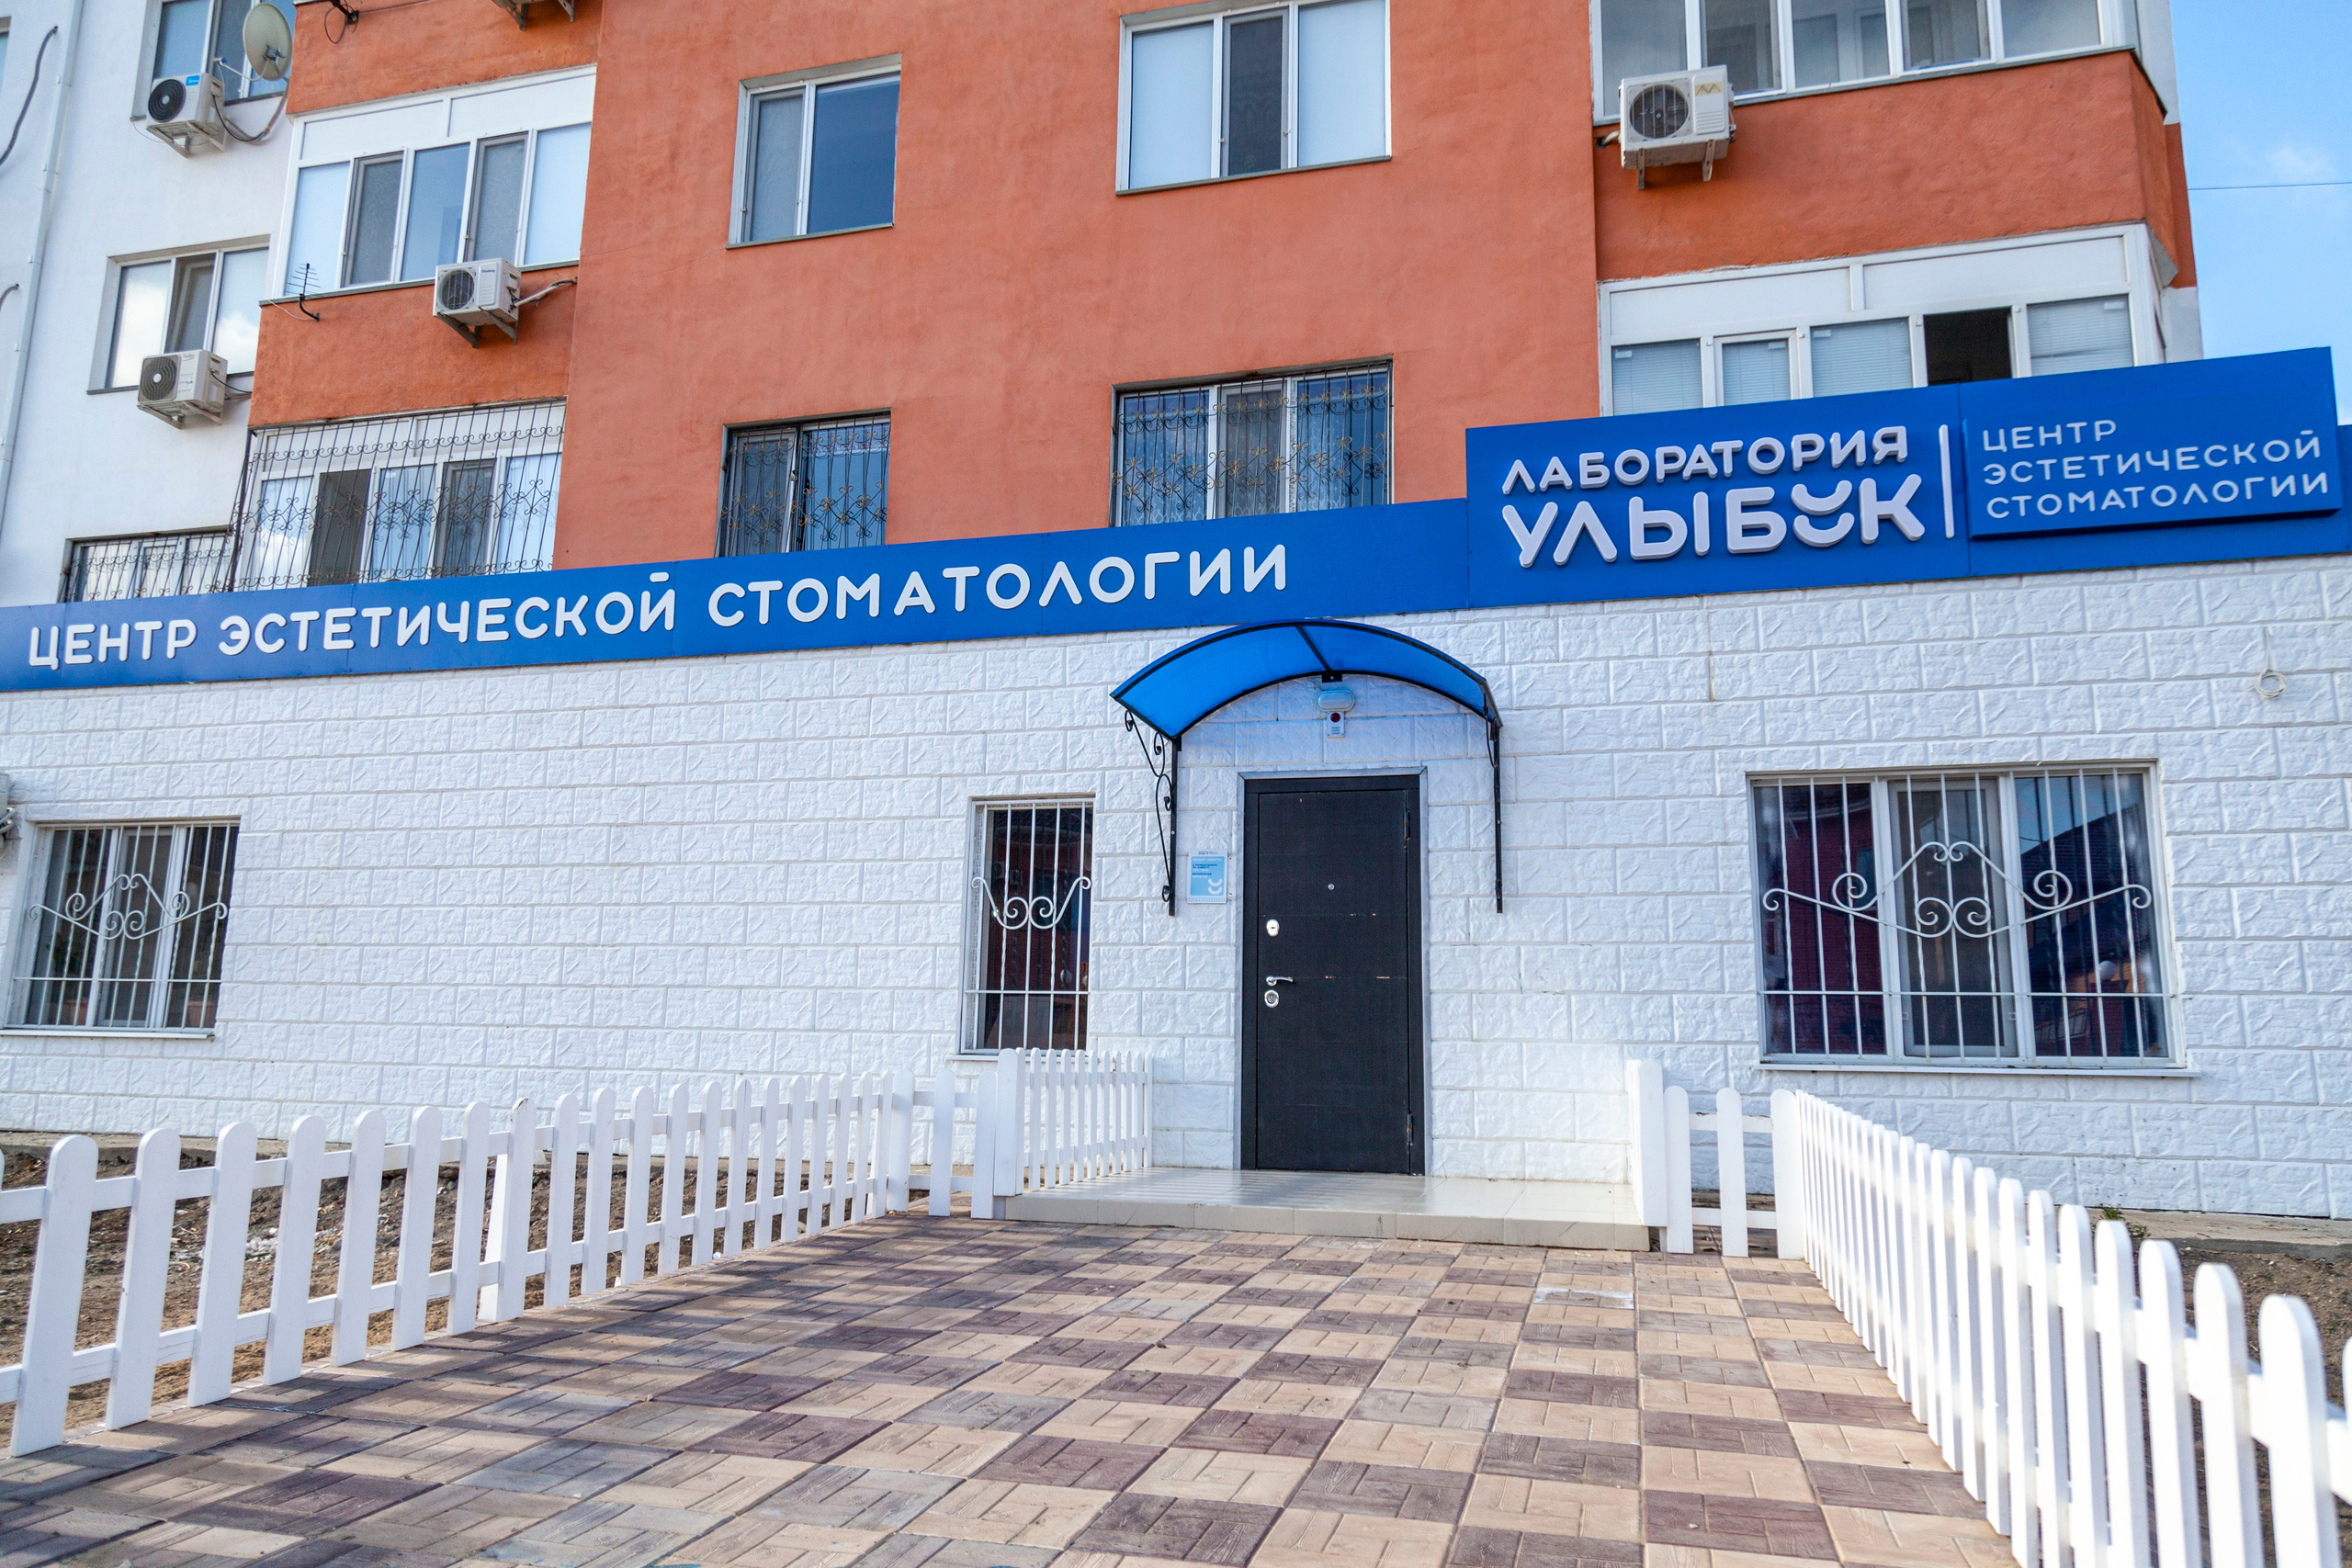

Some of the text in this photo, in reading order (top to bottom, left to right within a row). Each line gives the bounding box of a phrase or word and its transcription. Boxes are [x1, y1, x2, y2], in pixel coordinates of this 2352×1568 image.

[1502, 425, 1908, 495] ЛАБОРАТОРИЯ
[1983, 420, 2117, 453] ЦЕНТР
[1983, 430, 2321, 485] ЭСТЕТИЧЕСКОЙ
[1986, 472, 2329, 519] СТОМАТОЛОГИИ
[28, 544, 1286, 671] ЦЕНТР ЭСТЕТИЧЕСКОЙ СТОМАТОЛОГИИ
